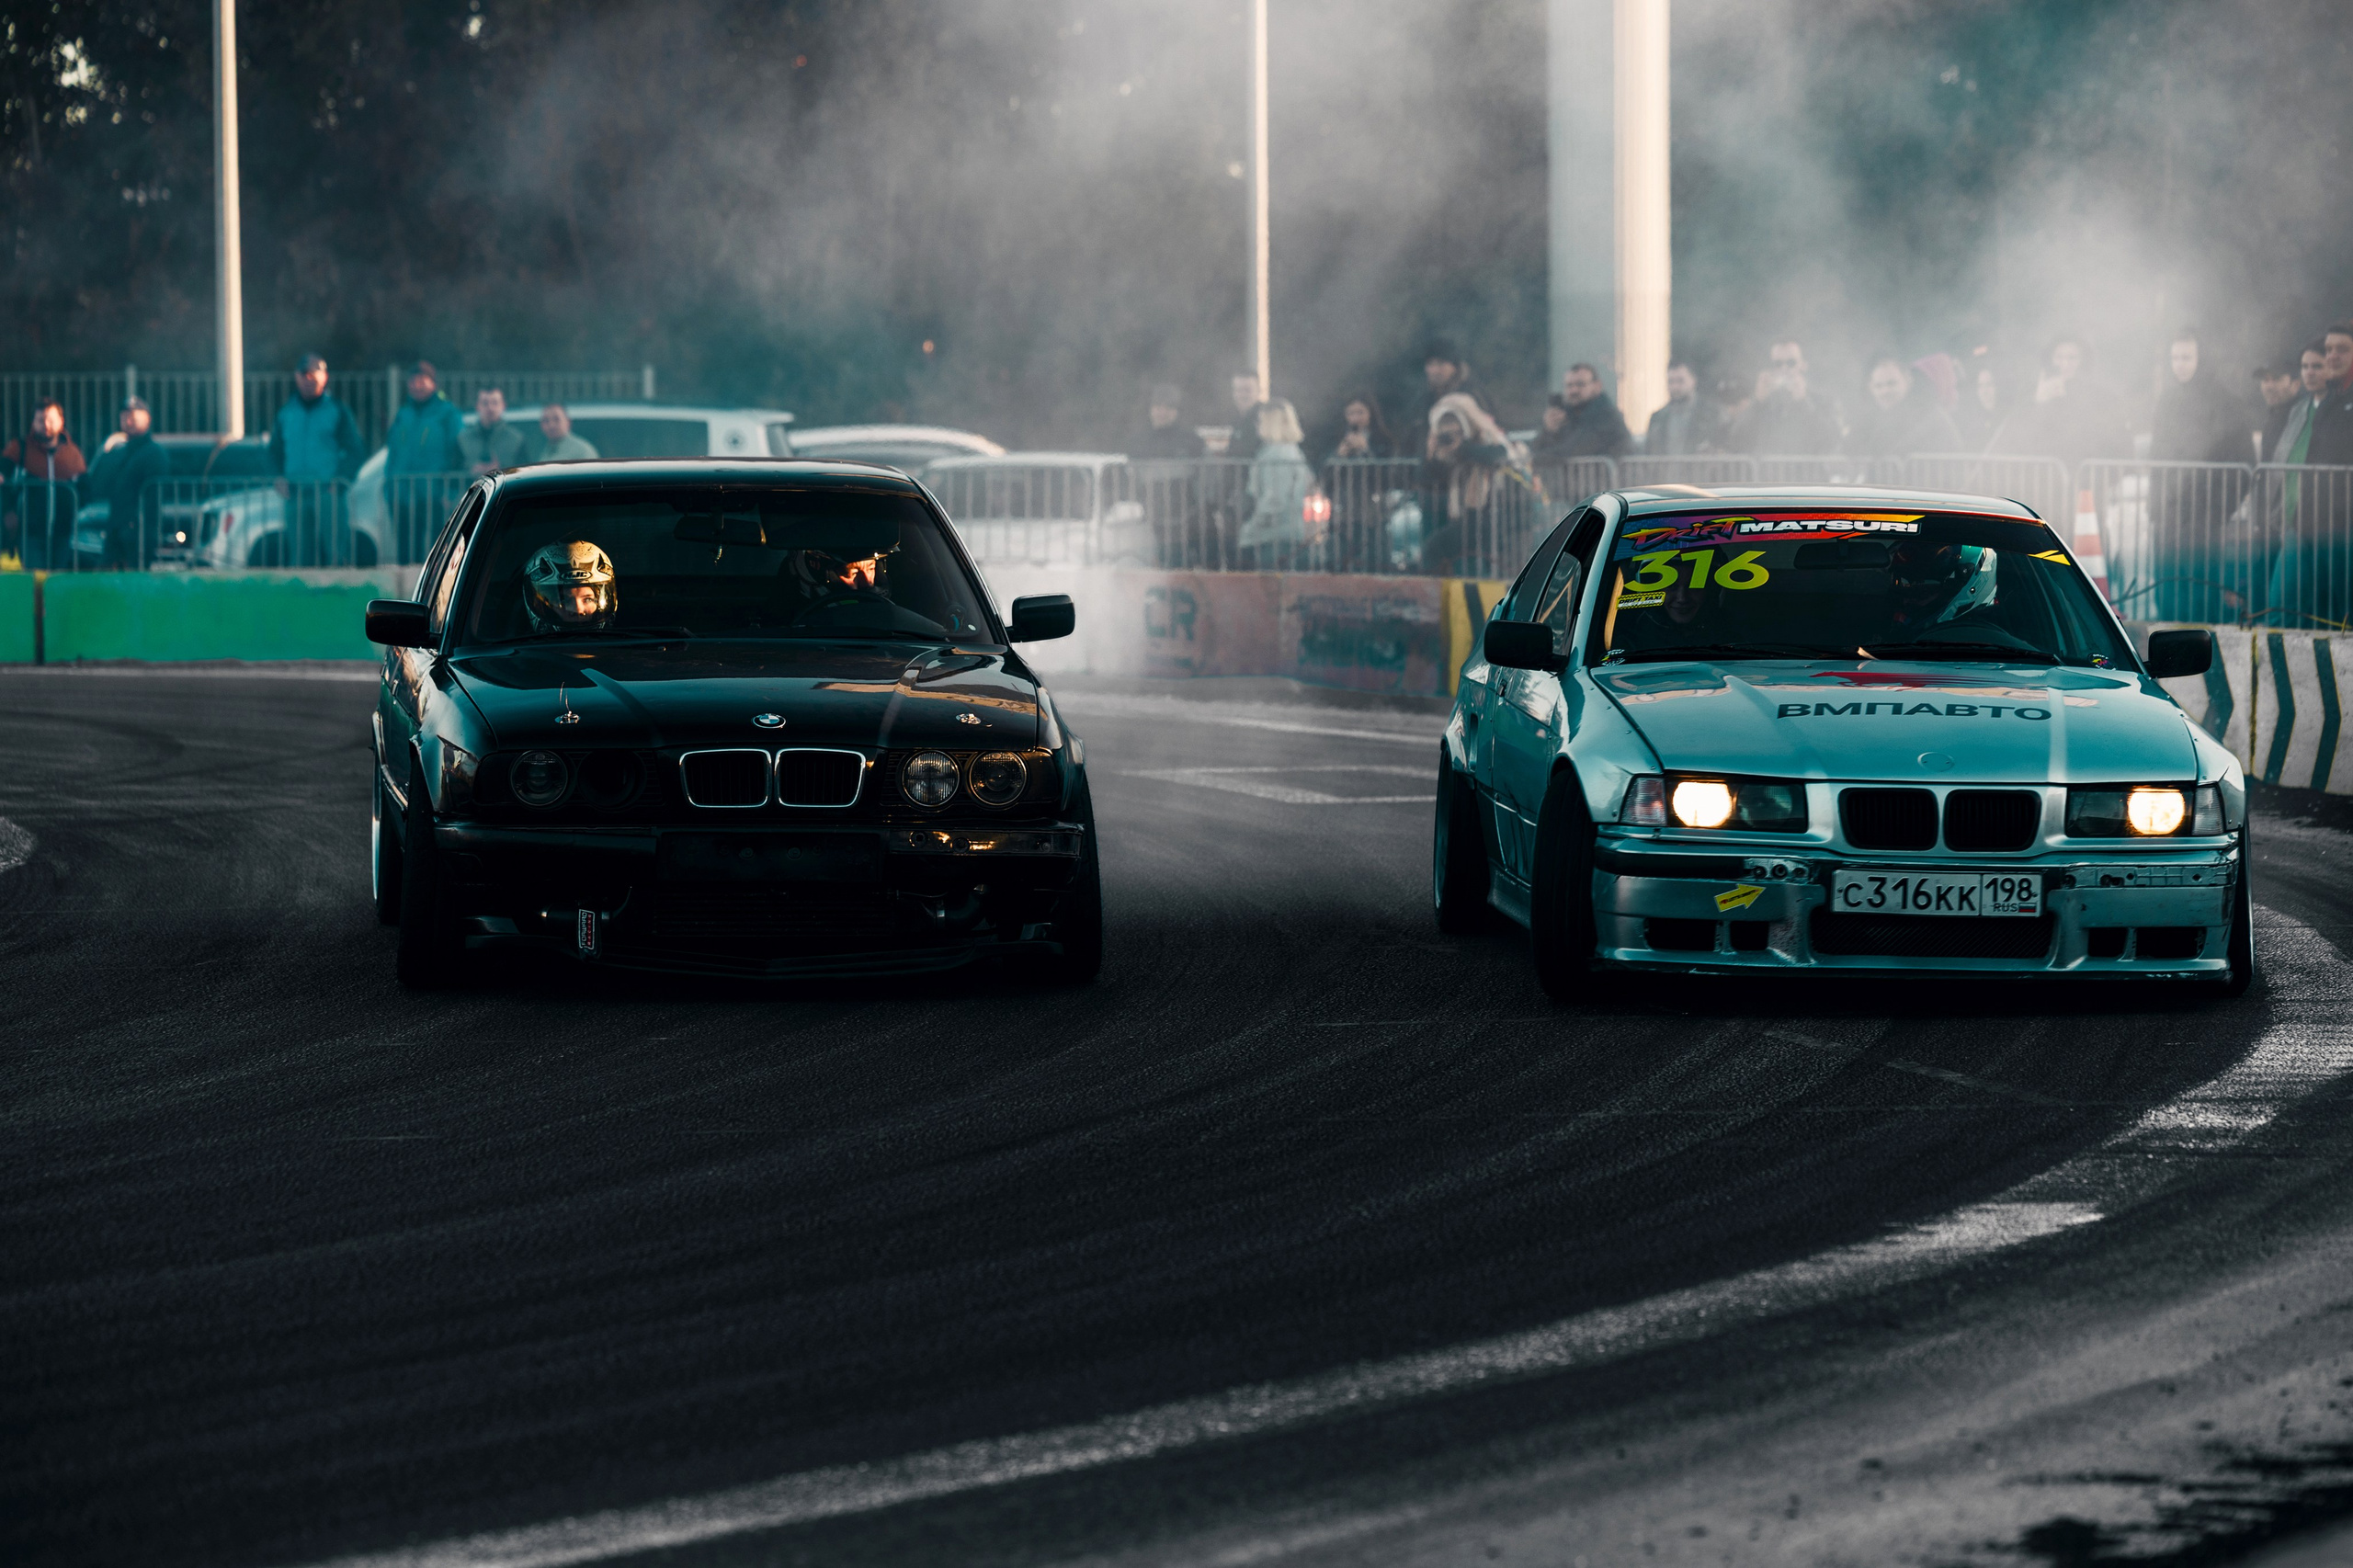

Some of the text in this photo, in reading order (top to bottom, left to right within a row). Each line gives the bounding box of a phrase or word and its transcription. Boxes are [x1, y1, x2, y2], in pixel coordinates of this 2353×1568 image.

[1739, 520, 1919, 533] MATSURI
[1624, 549, 1770, 590] 316
[1777, 702, 2052, 721] ВМПАВТО
[1984, 877, 2033, 902] 198
[1993, 903, 2018, 913] RUS
